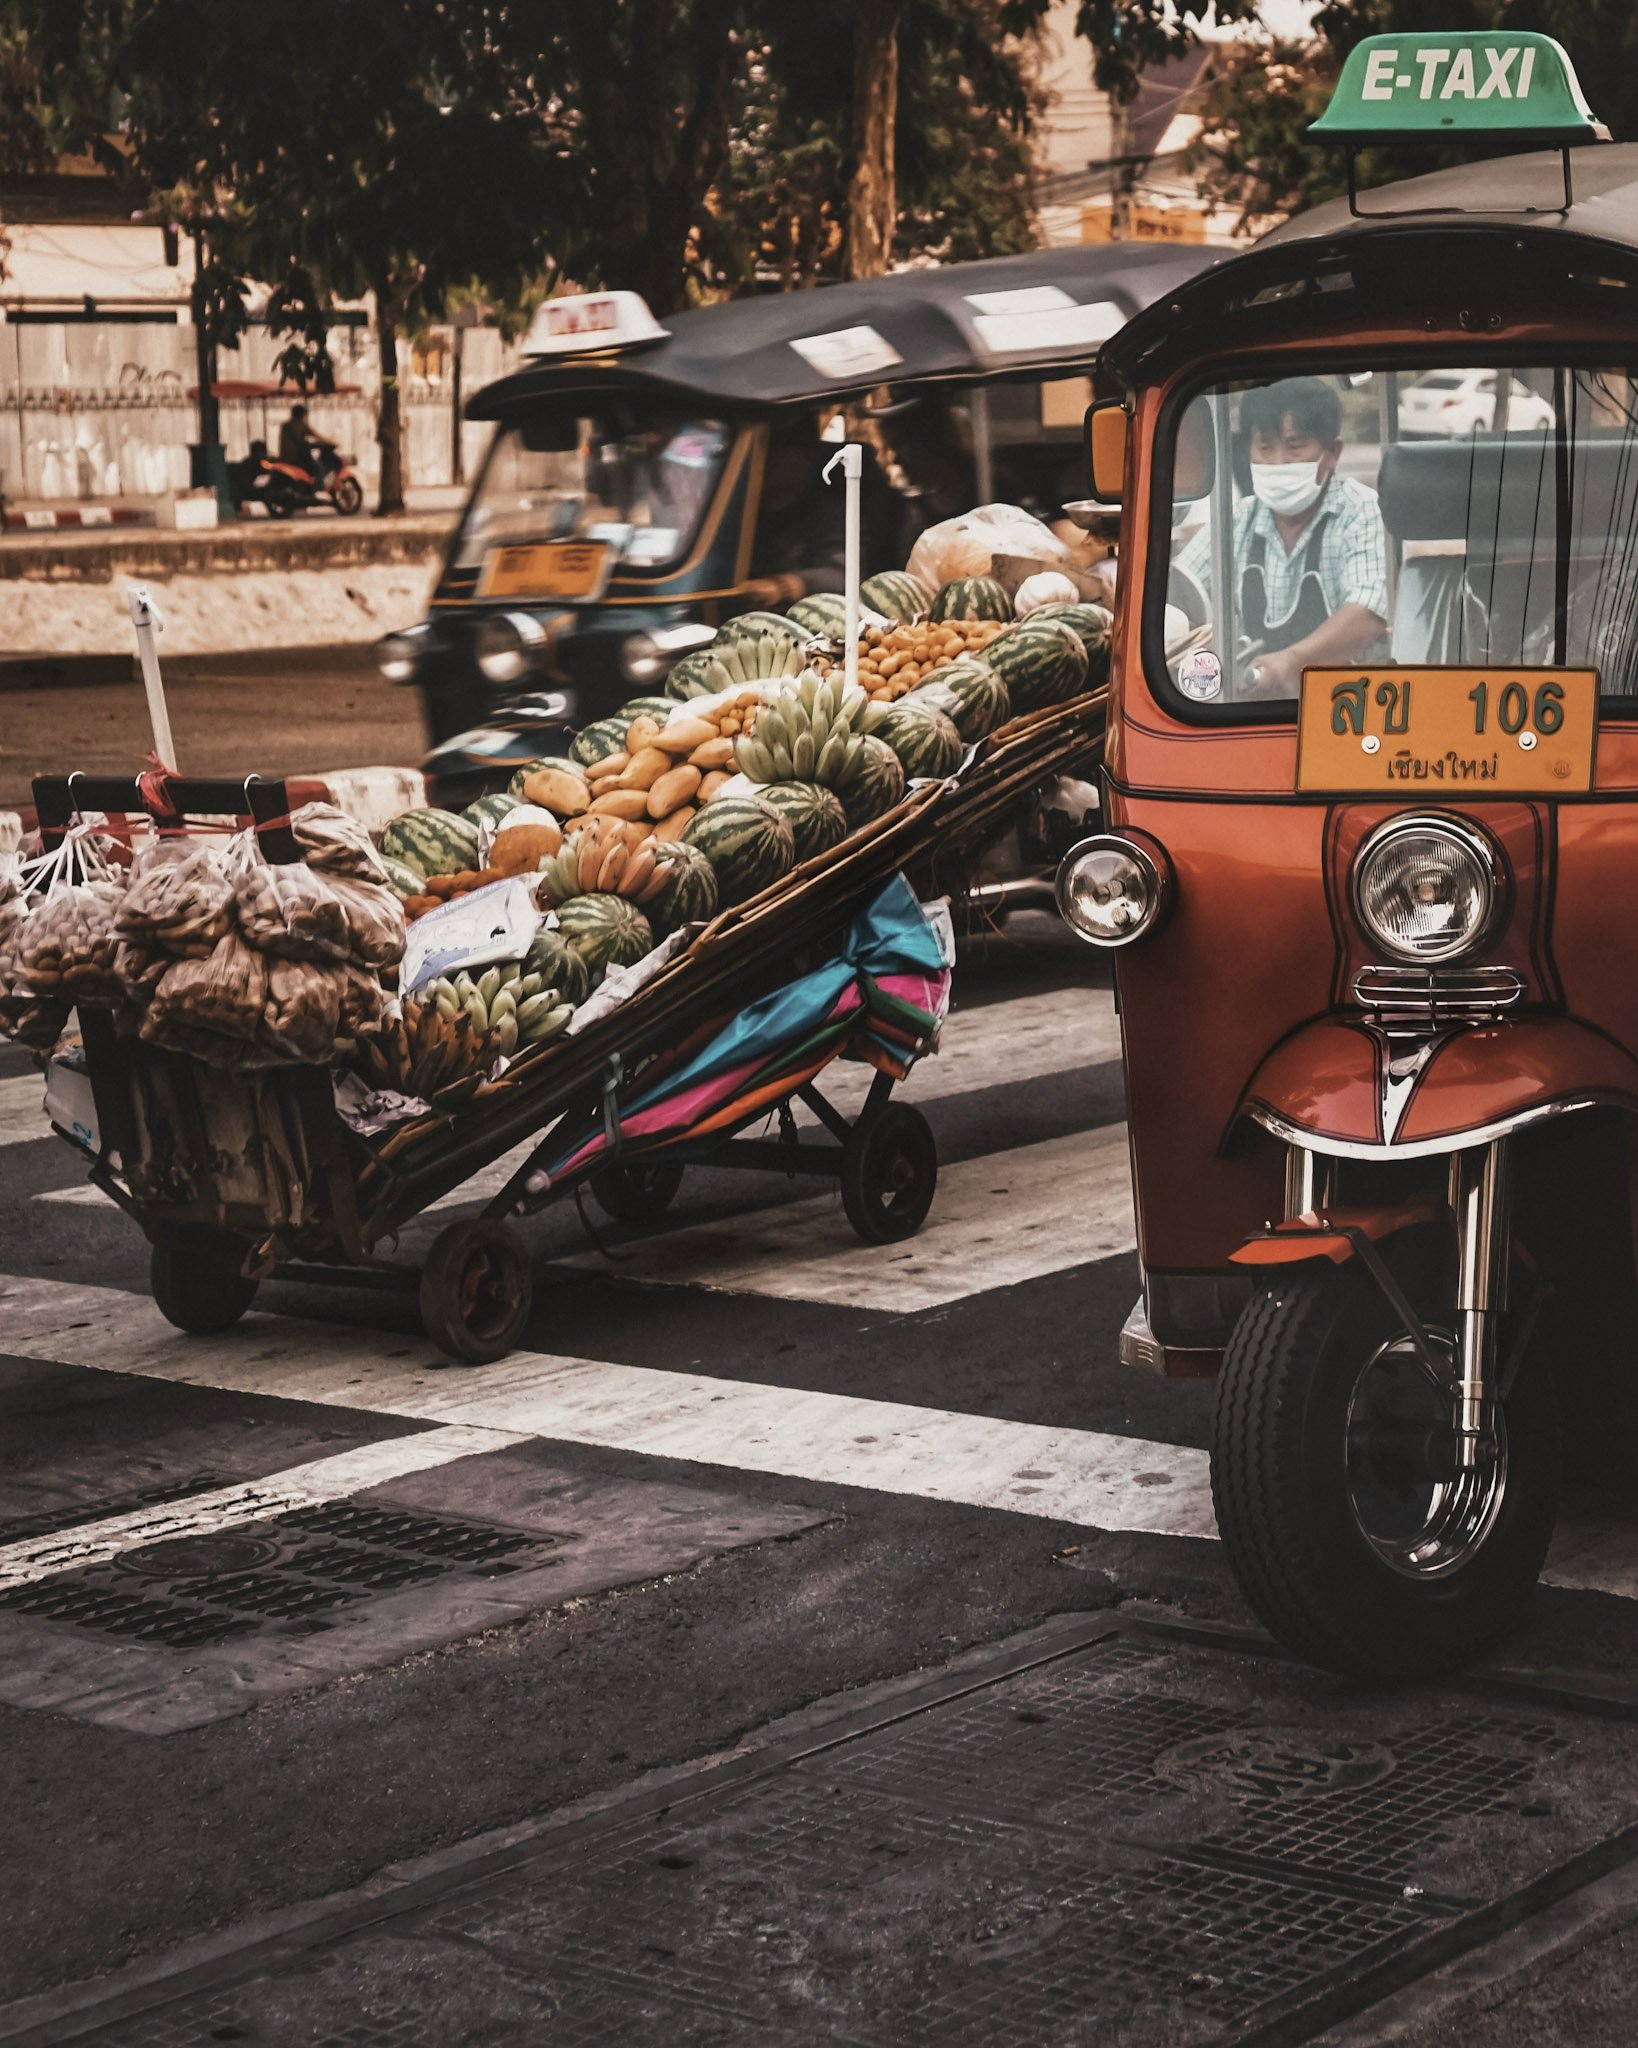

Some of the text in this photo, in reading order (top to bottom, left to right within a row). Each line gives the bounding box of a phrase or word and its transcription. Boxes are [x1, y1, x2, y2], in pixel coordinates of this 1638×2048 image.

[1361, 47, 1536, 100] E-TAXI
[1331, 677, 1566, 735] สข 106
[1387, 750, 1499, 780] เชียงใหม่
